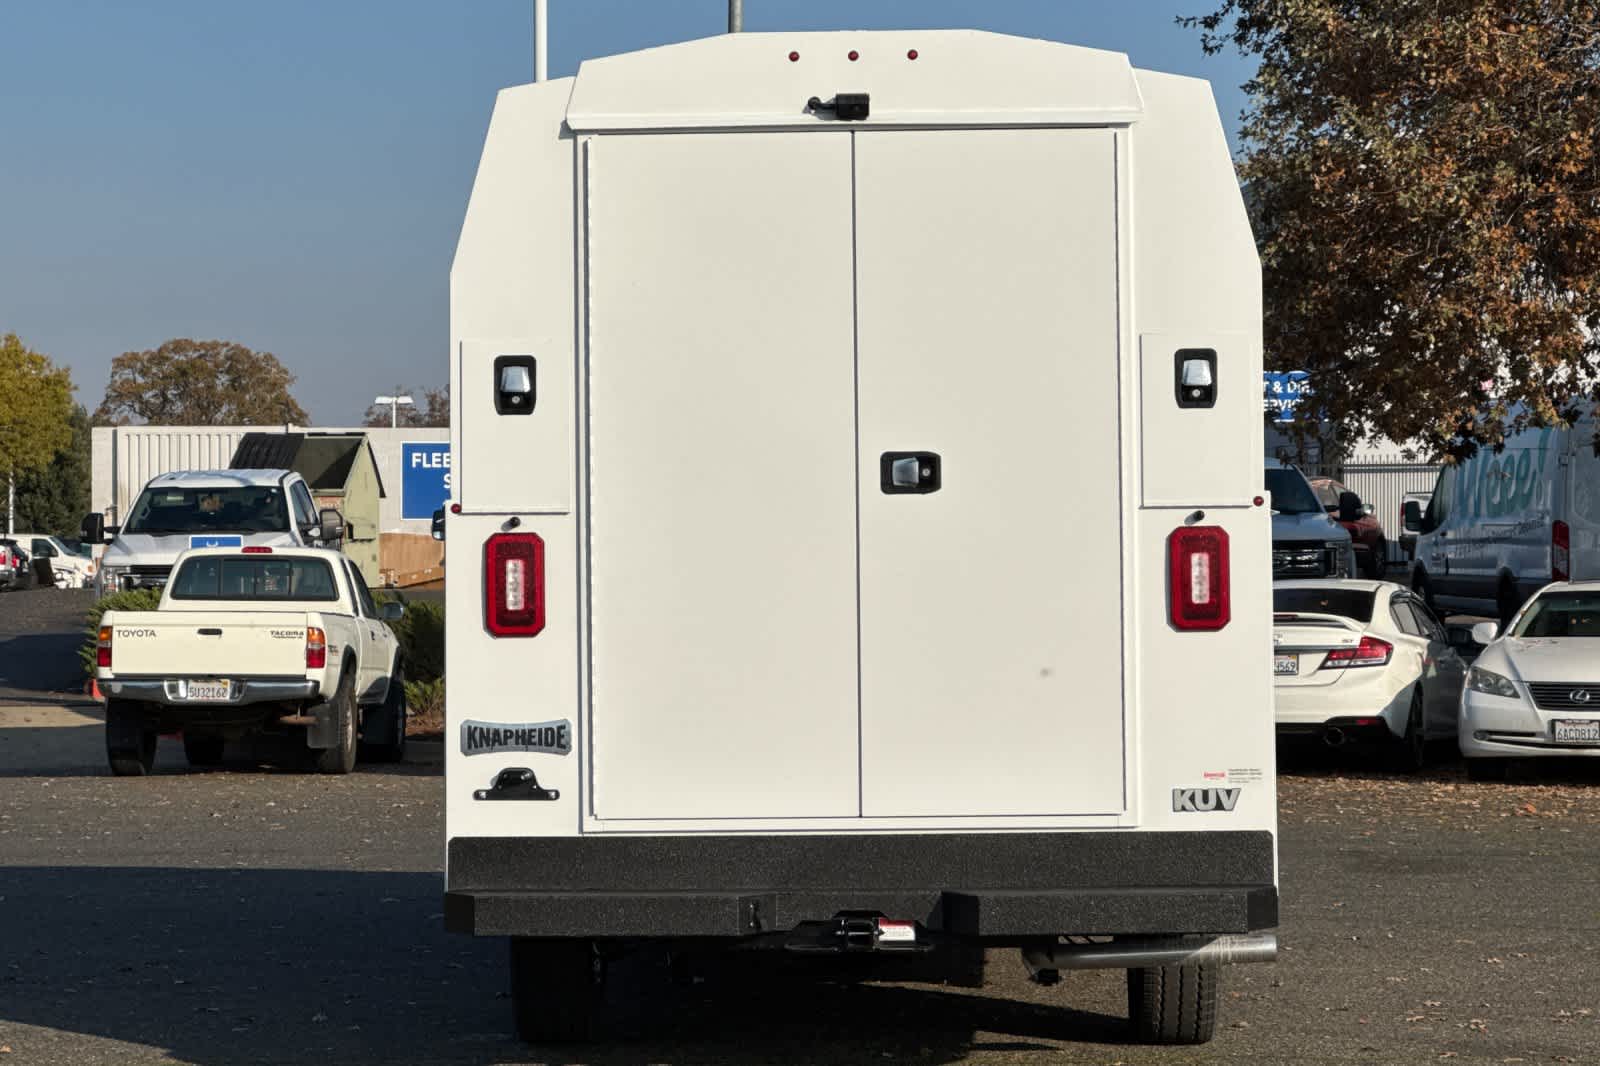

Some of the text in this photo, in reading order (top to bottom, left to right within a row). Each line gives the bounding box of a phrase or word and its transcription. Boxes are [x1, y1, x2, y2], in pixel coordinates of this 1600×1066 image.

[1273, 381, 1284, 394] &
[116, 629, 157, 638] TOYOTA
[466, 724, 567, 750] KNAPHEIDE
[1172, 787, 1242, 812] KUV
